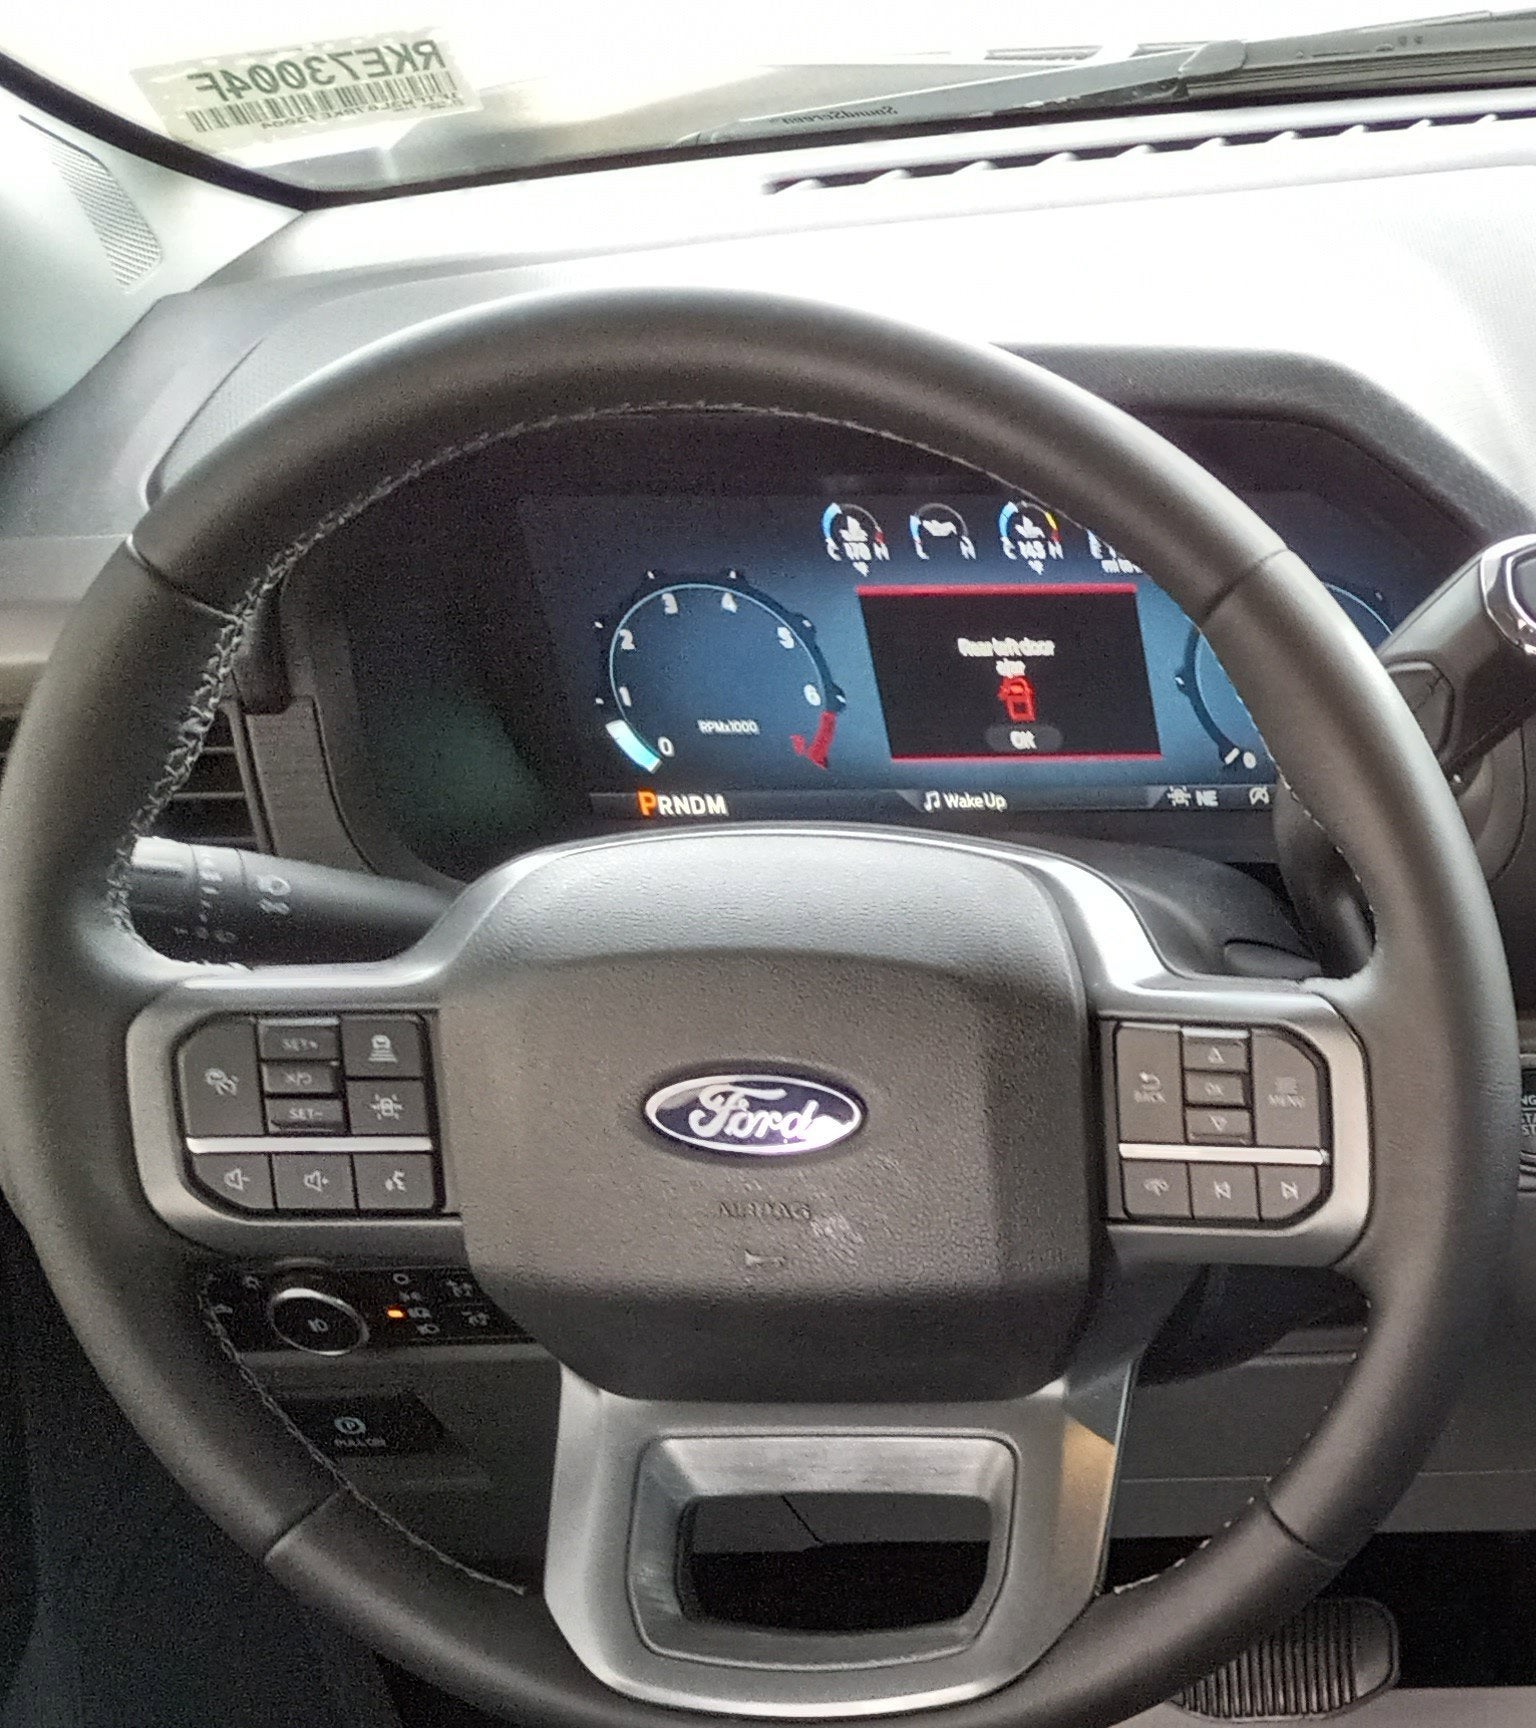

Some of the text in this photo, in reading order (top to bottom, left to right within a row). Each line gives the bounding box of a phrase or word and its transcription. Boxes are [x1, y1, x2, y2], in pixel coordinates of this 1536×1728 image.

[662, 593, 678, 614] 3
[721, 592, 738, 613] 4
[619, 629, 635, 650] 2
[777, 627, 794, 648] 5
[620, 686, 632, 707] 1
[803, 684, 821, 706] 6
[698, 720, 760, 734] RPMx1000
[658, 736, 674, 757] 0
[1010, 731, 1037, 749] OK
[945, 793, 1007, 812] Wake Up
[1197, 791, 1218, 807] NE
[688, 1083, 820, 1138] Ford
[1267, 1093, 1306, 1108] MENU
